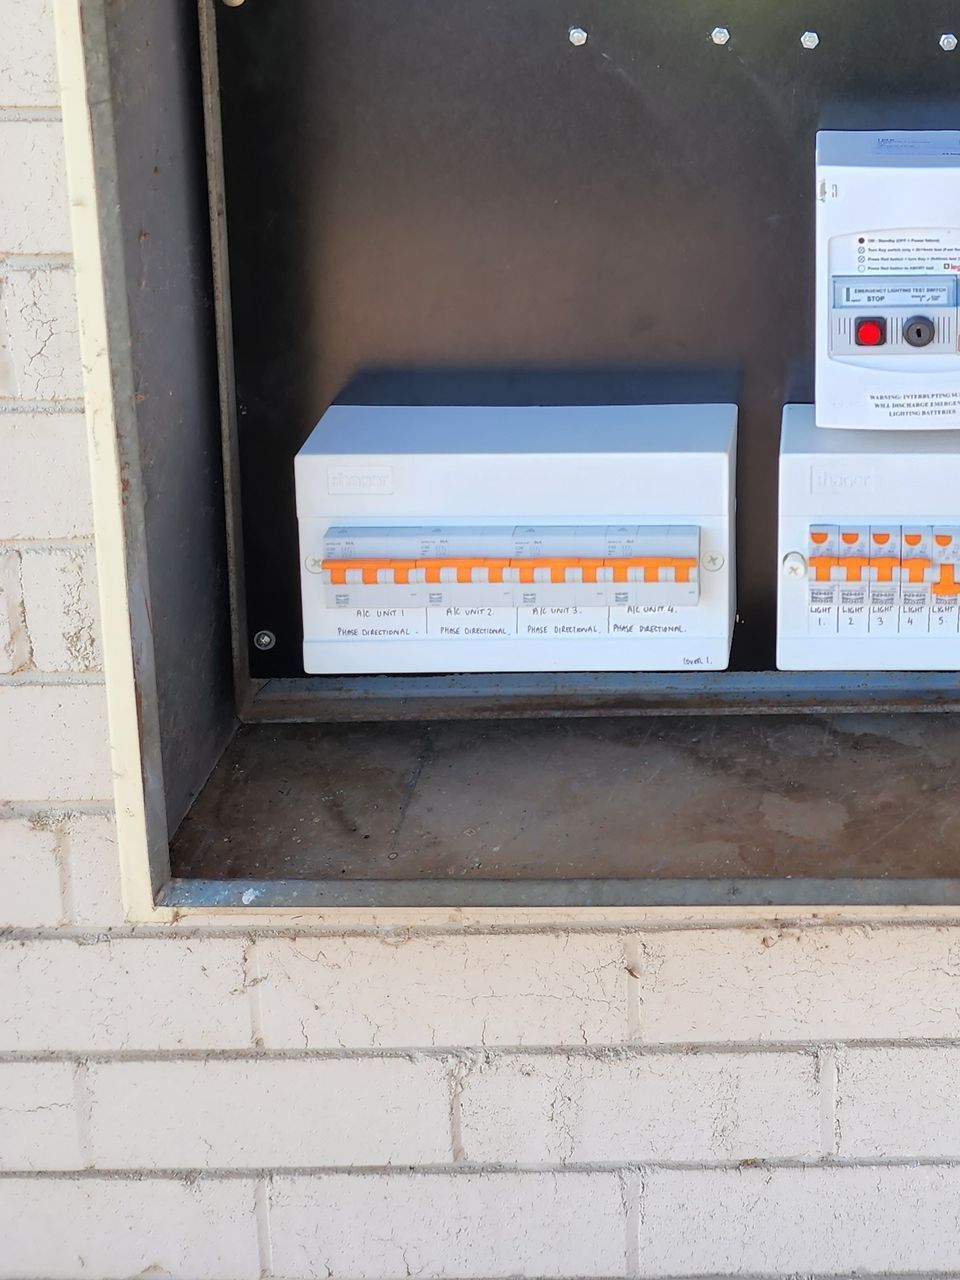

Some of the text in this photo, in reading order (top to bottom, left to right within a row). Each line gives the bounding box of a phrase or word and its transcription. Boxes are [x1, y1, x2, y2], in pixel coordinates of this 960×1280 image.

[922, 409, 956, 417] BATTERIES
[810, 606, 833, 614] LIGHT
[842, 606, 865, 614] LIGHT
[872, 605, 895, 614] LIGHT
[902, 605, 925, 614] LIGHT
[932, 605, 955, 613] LIGHT
[337, 627, 358, 636] PHASE
[440, 626, 460, 635] PHASE
[527, 625, 547, 634] PHASE
[613, 624, 634, 632] PHASE
